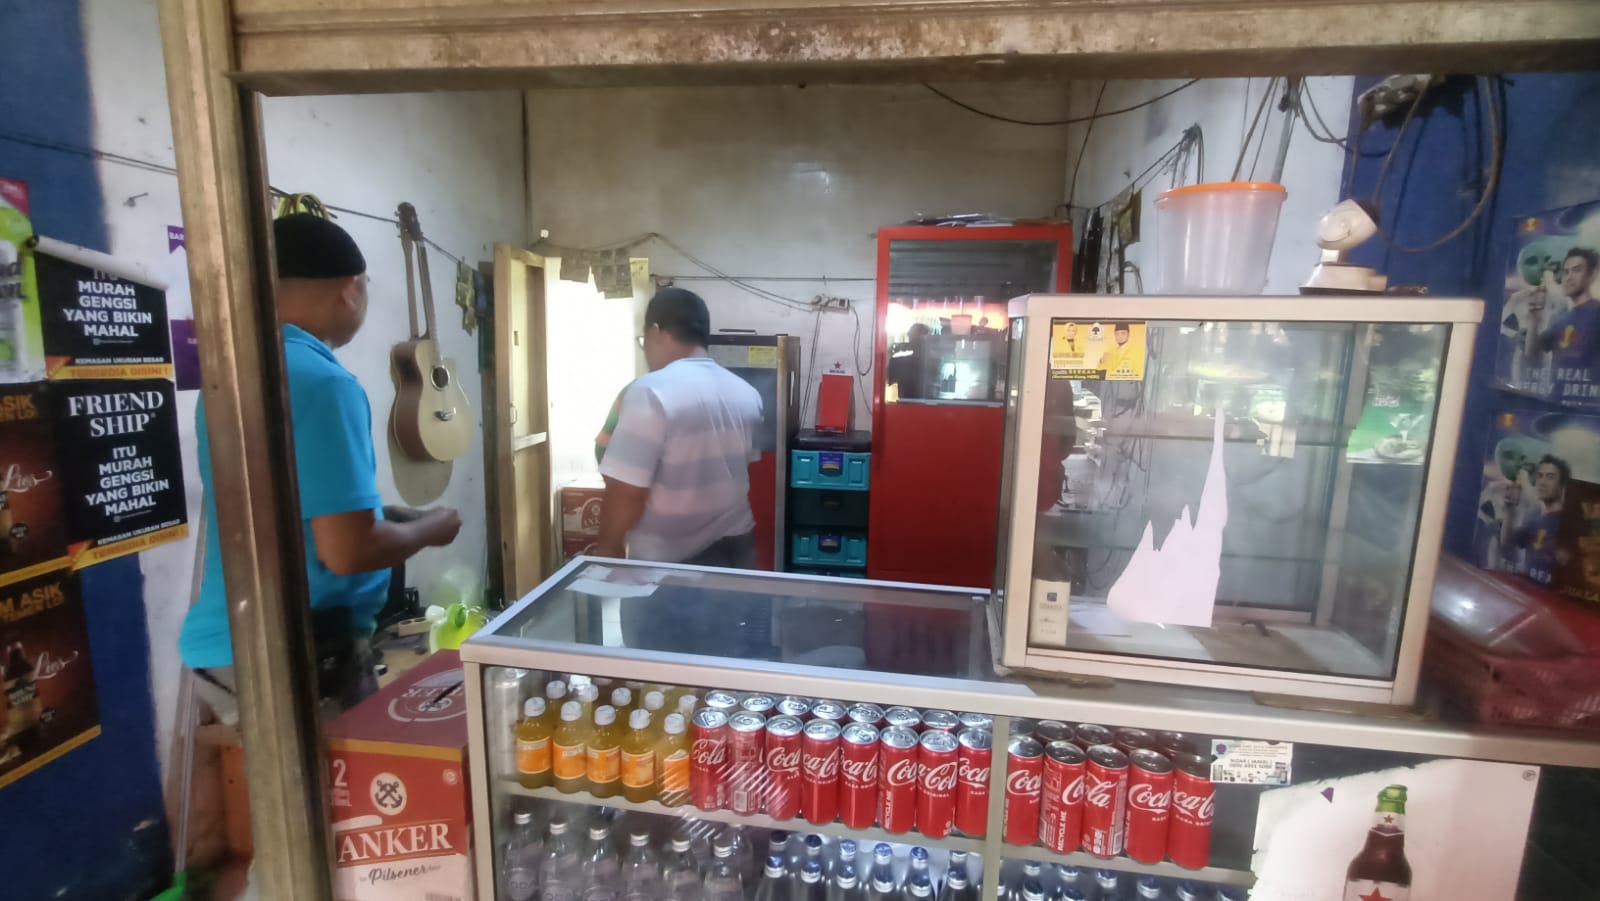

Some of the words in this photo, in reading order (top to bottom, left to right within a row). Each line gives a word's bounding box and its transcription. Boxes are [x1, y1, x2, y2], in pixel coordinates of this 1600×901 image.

[78, 281, 136, 296] MURAH
[78, 296, 137, 310] GENGSI
[62, 308, 109, 323] YANG
[113, 311, 152, 323] BIKIN
[84, 324, 139, 337] MAHAL
[68, 391, 164, 417] FRIEND
[112, 445, 137, 460] ITU
[98, 457, 152, 476] MURAH
[100, 469, 154, 489] GENGSI
[85, 488, 128, 506] YANG
[132, 479, 170, 497] BIKIN
[105, 496, 157, 516] MAHAL
[338, 823, 453, 863] ANKER
[368, 864, 427, 886] Pilsener
